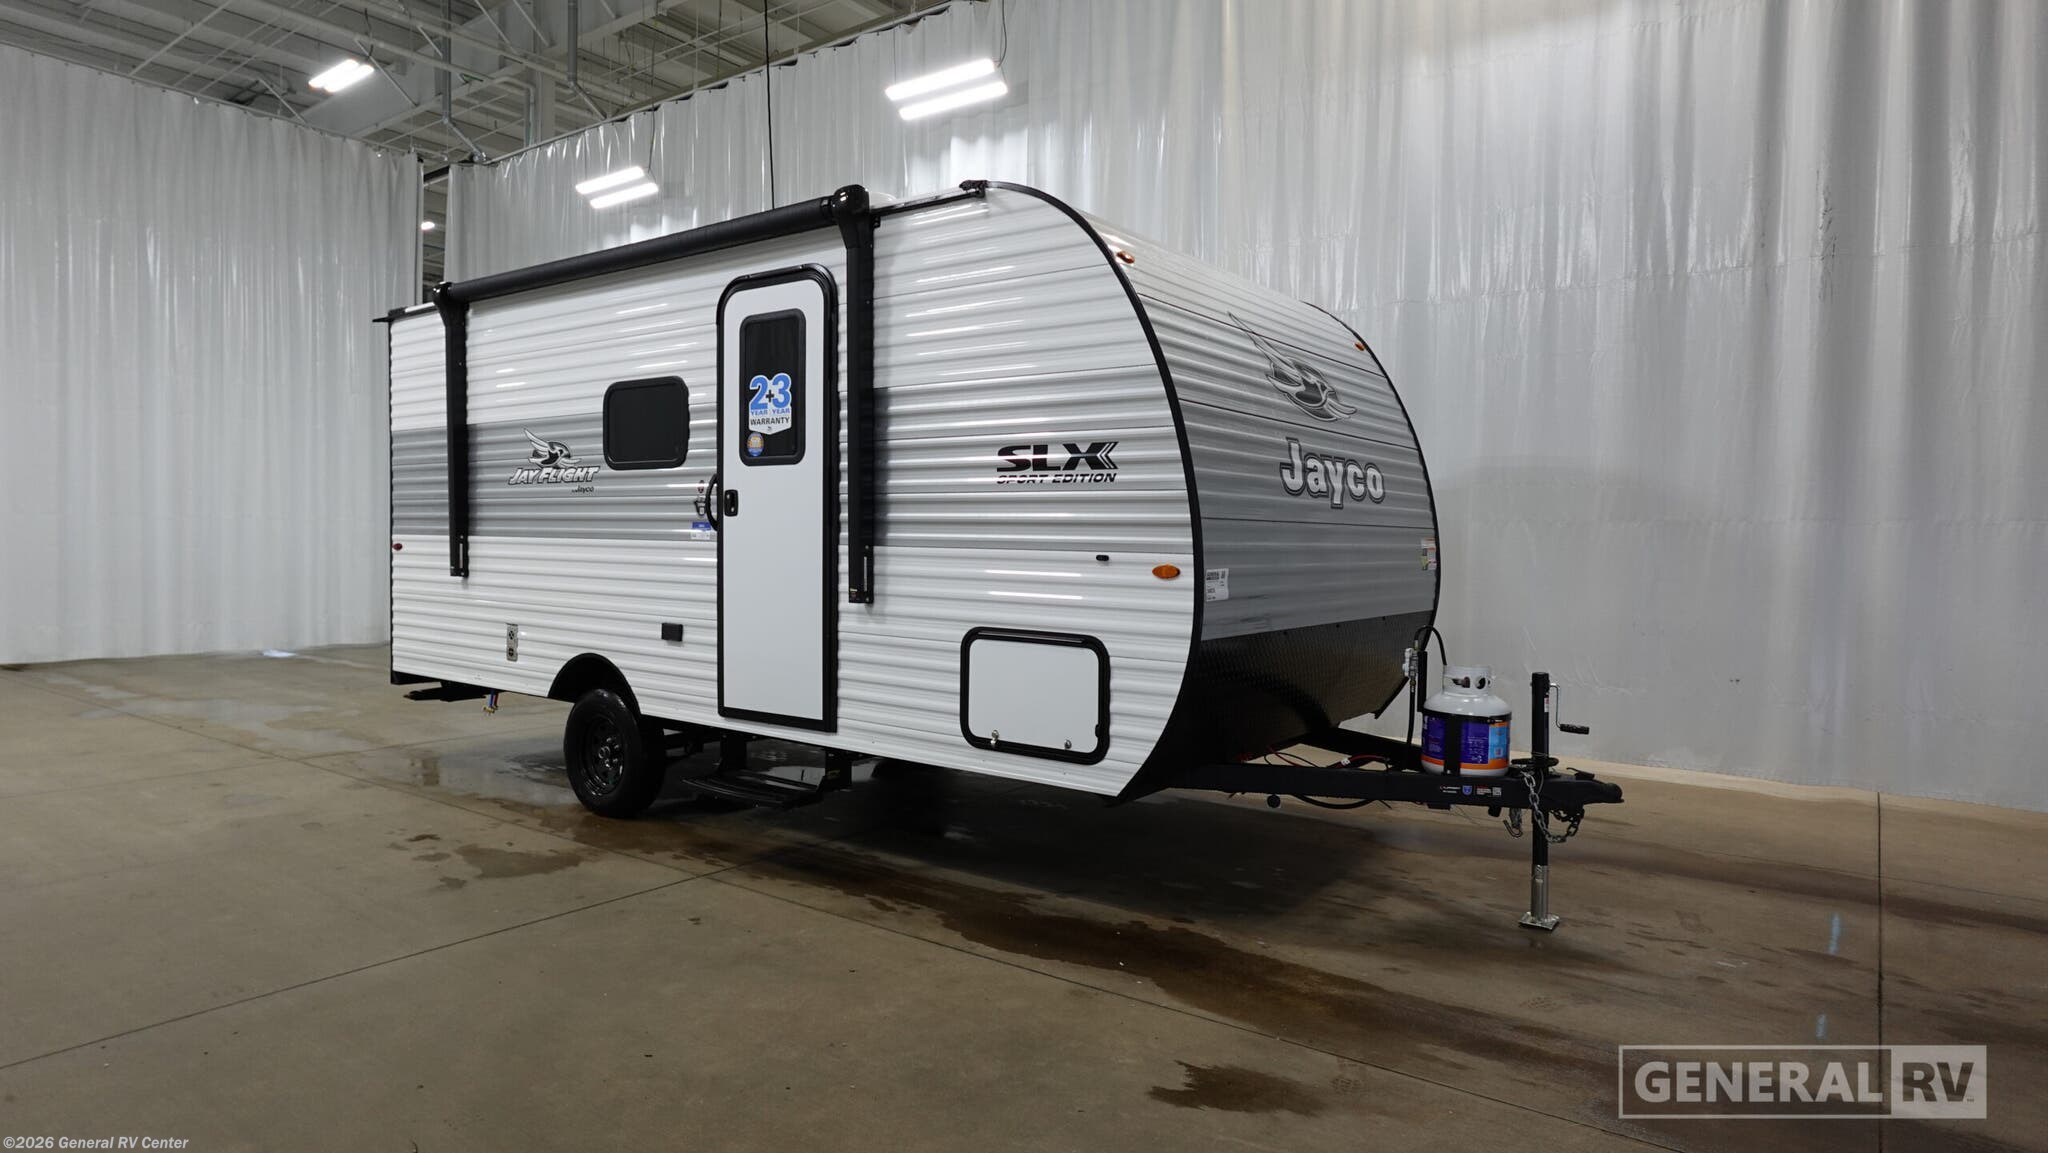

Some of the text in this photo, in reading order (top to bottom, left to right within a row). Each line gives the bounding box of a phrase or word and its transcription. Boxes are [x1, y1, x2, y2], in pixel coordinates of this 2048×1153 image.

[750, 417, 790, 426] WARRANTY
[997, 442, 1119, 472] SLX
[508, 466, 600, 485] JAY FLIGHT
[997, 473, 1117, 484] SPORT EDITION
[1280, 437, 1385, 509] Jayco
